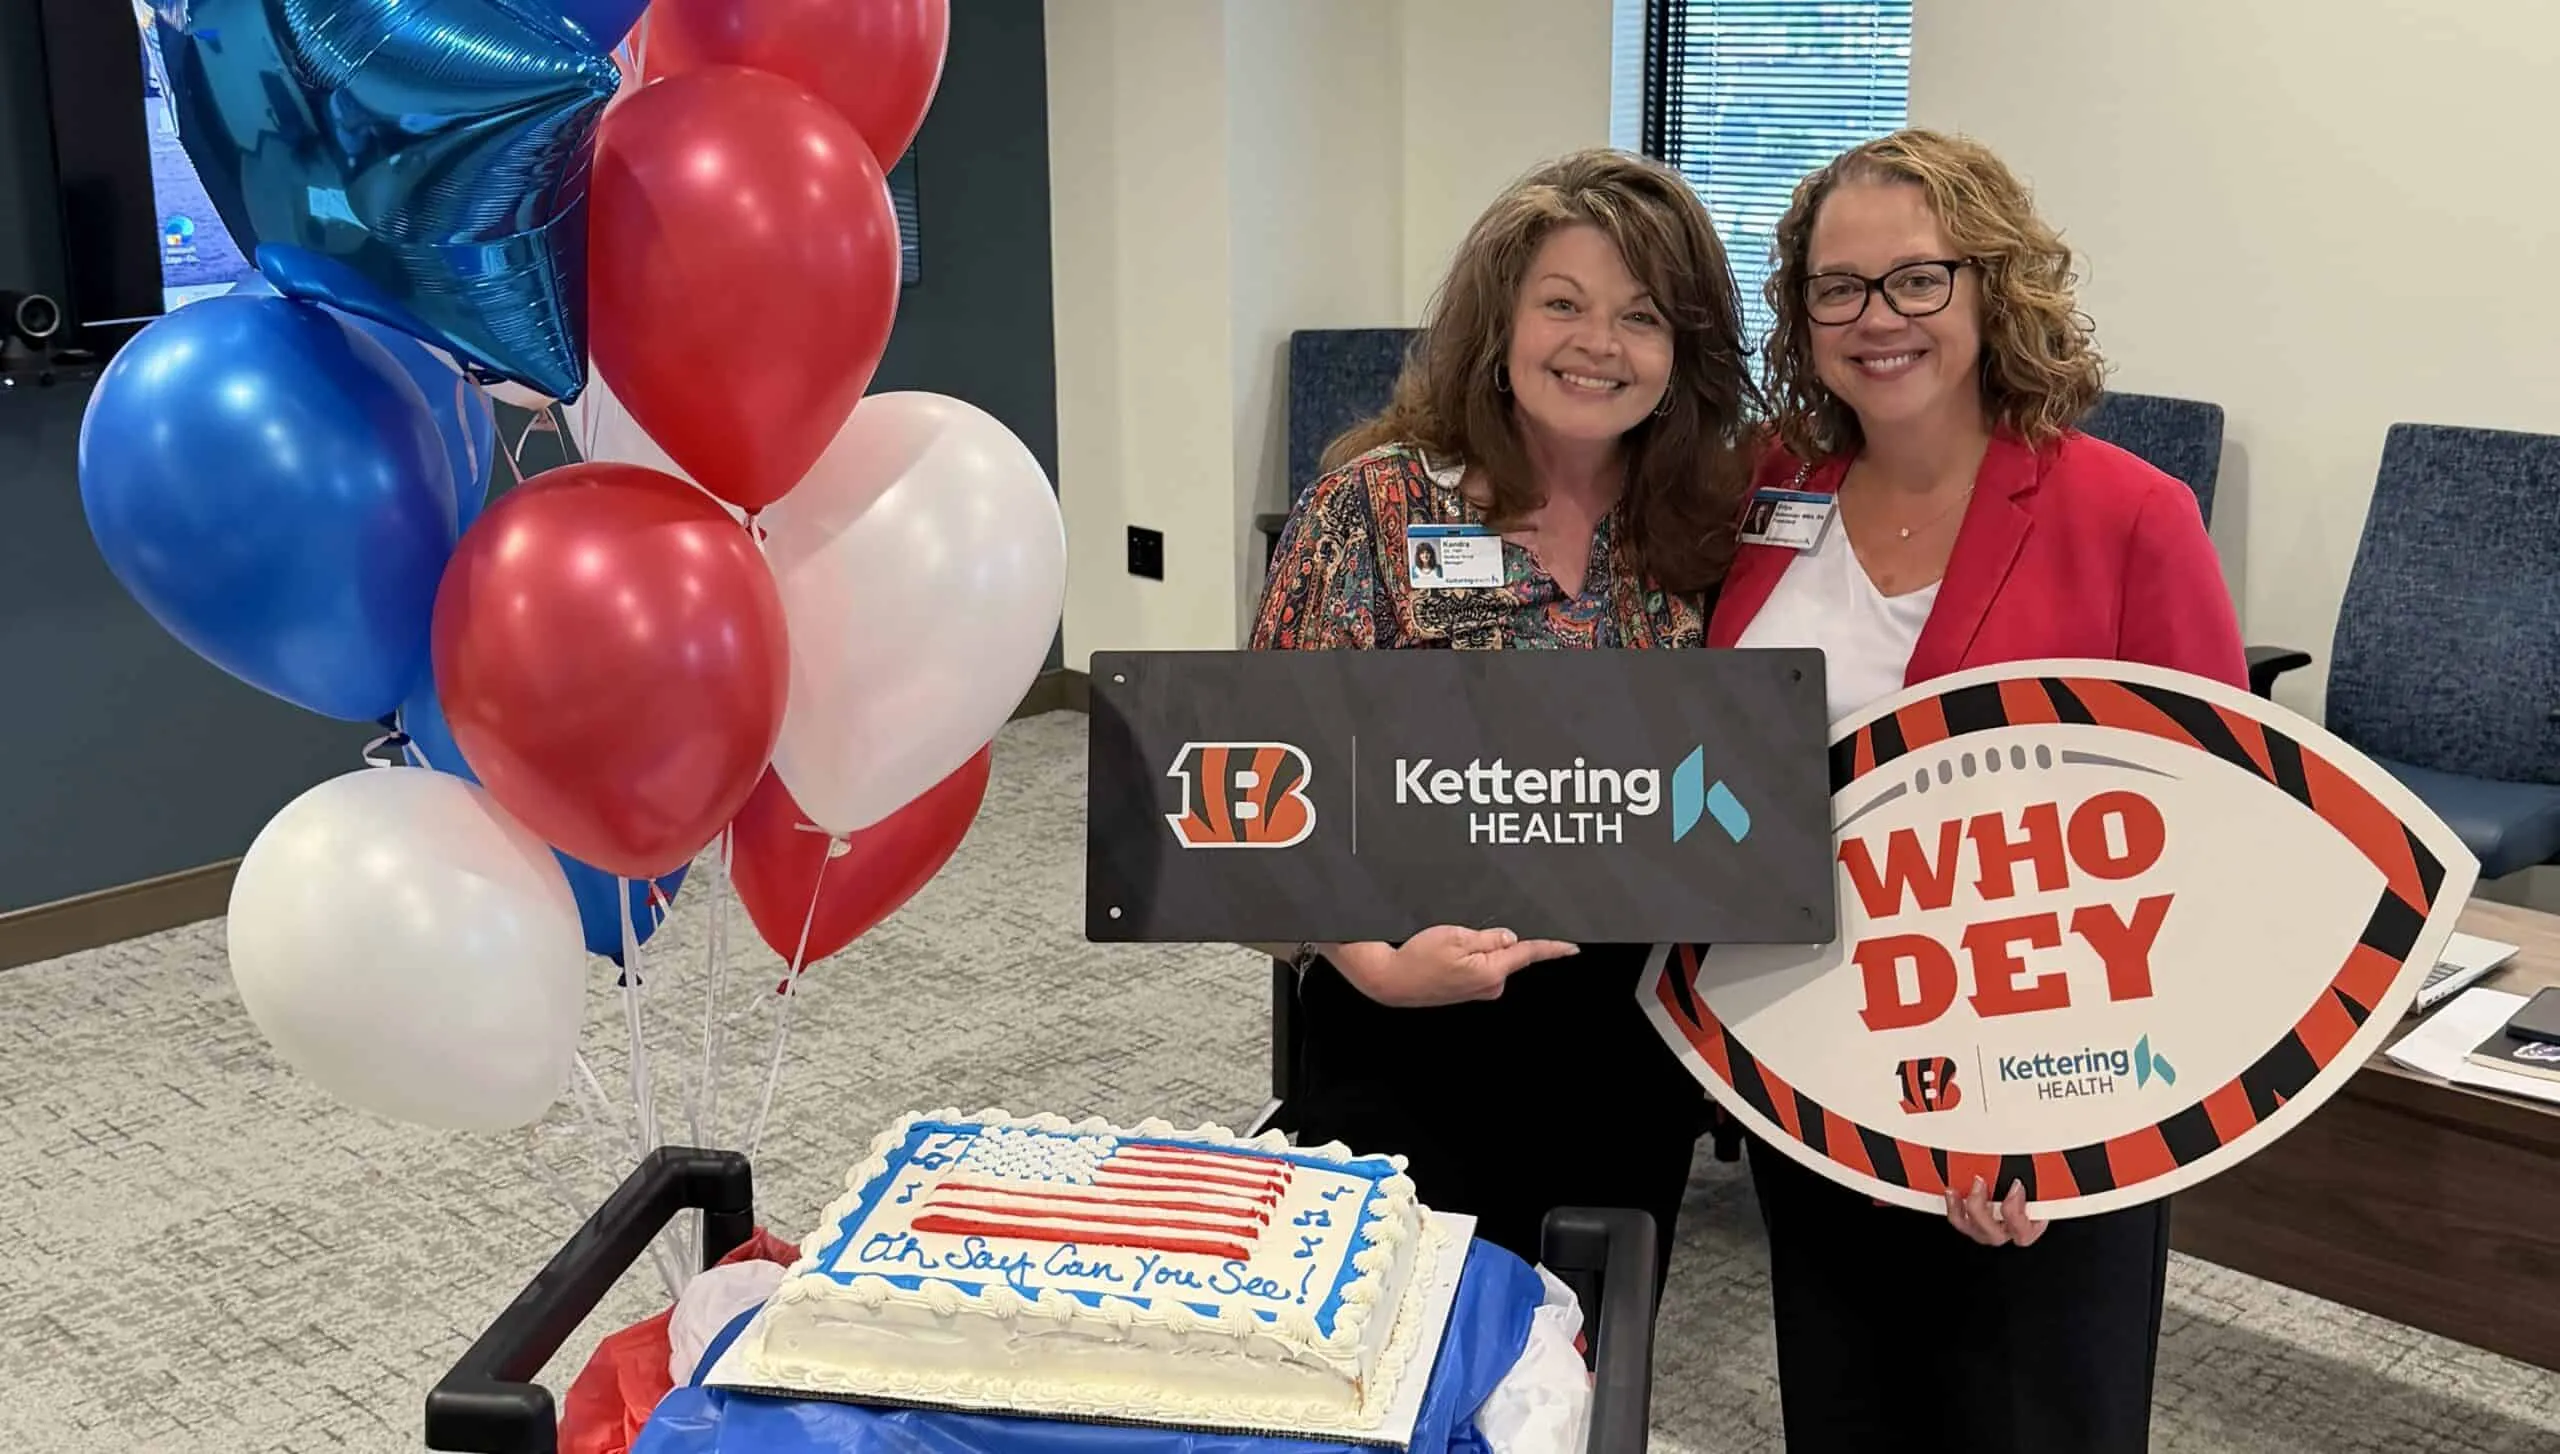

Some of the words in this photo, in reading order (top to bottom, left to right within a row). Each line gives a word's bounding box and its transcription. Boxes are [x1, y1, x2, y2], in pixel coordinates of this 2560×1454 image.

[1396, 757, 1661, 816] Kettering
[1469, 812, 1623, 844] HEALTH
[1837, 790, 2166, 919] WHO
[1851, 893, 2176, 1032] DEY
[1999, 1048, 2130, 1082] Kettering
[2037, 1076, 2115, 1100] HEALTH
[860, 1231, 938, 1269] Oh
[946, 1236, 1035, 1289] Say
[1043, 1243, 1124, 1284] Can
[1134, 1254, 1203, 1292] You
